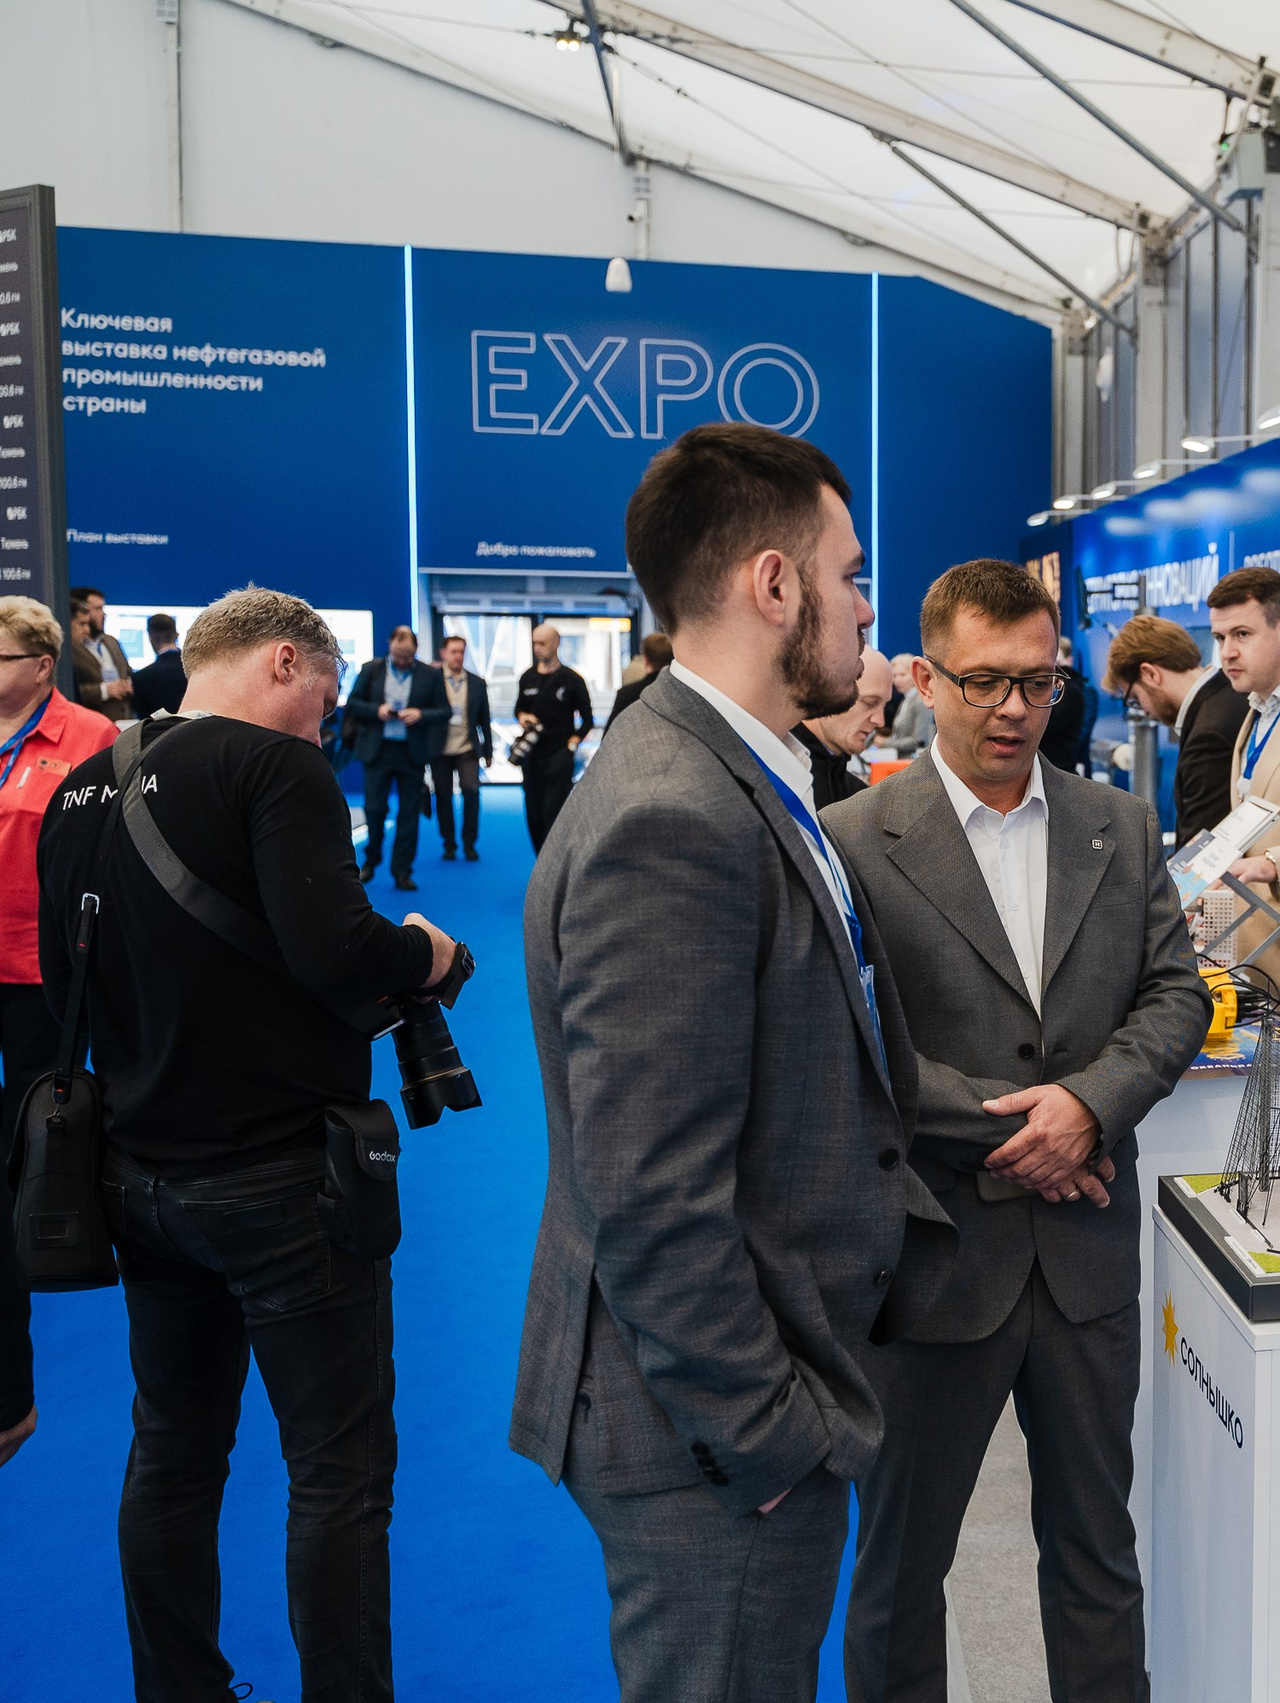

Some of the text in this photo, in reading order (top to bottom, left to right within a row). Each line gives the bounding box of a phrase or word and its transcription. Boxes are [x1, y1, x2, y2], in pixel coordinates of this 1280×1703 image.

[61, 307, 173, 333] Ключевая
[61, 340, 326, 368] выставка нефтегазовой
[62, 367, 264, 392] промышленности
[471, 330, 820, 440] EXPO
[62, 395, 147, 417] страны
[1138, 541, 1220, 612] ННОВАЦИЙ
[62, 774, 158, 811] TNF MIA
[369, 1150, 396, 1163] Godox
[1180, 1336, 1244, 1451] СОЛНЫШКО
